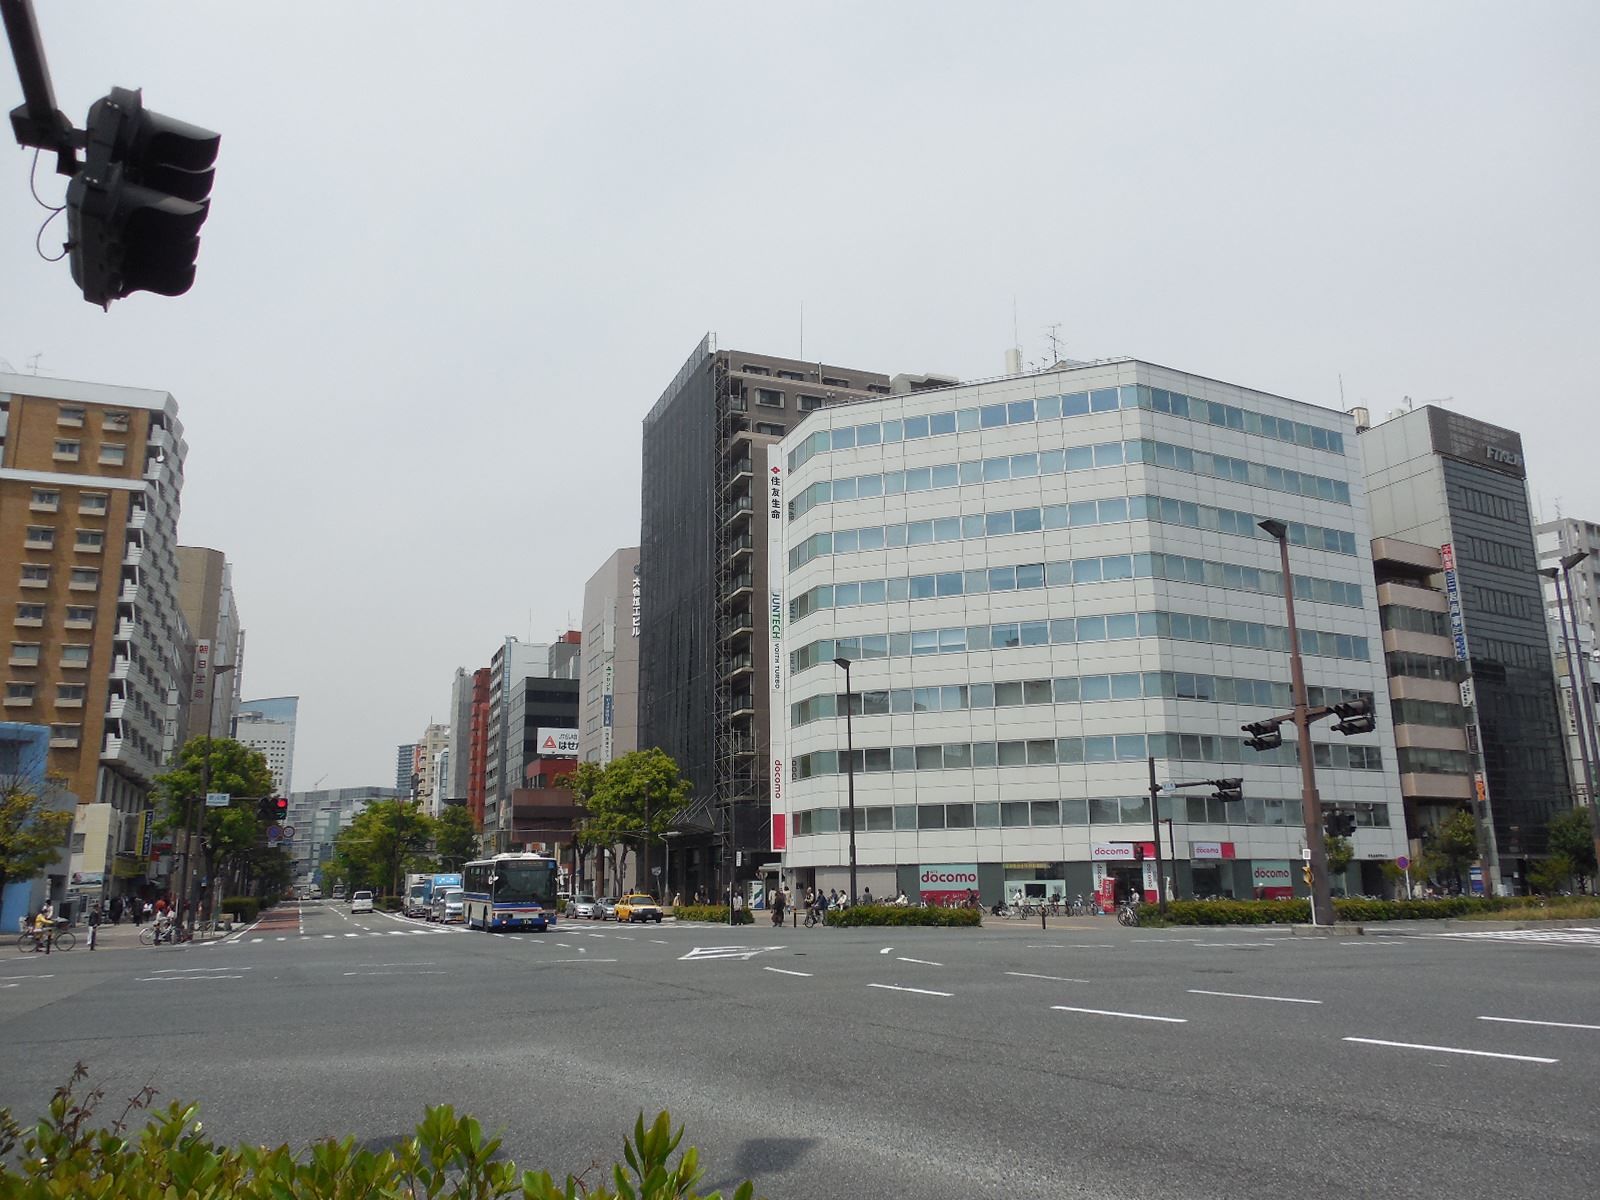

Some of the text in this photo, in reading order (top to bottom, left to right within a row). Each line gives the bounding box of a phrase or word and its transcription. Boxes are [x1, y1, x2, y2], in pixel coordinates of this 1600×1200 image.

[771, 476, 781, 520] 住友生命
[772, 593, 781, 639] JUNTECH
[774, 759, 783, 799] docomo
[1094, 847, 1130, 855] docomo
[921, 870, 977, 883] docomo
[1254, 866, 1290, 878] docomo
